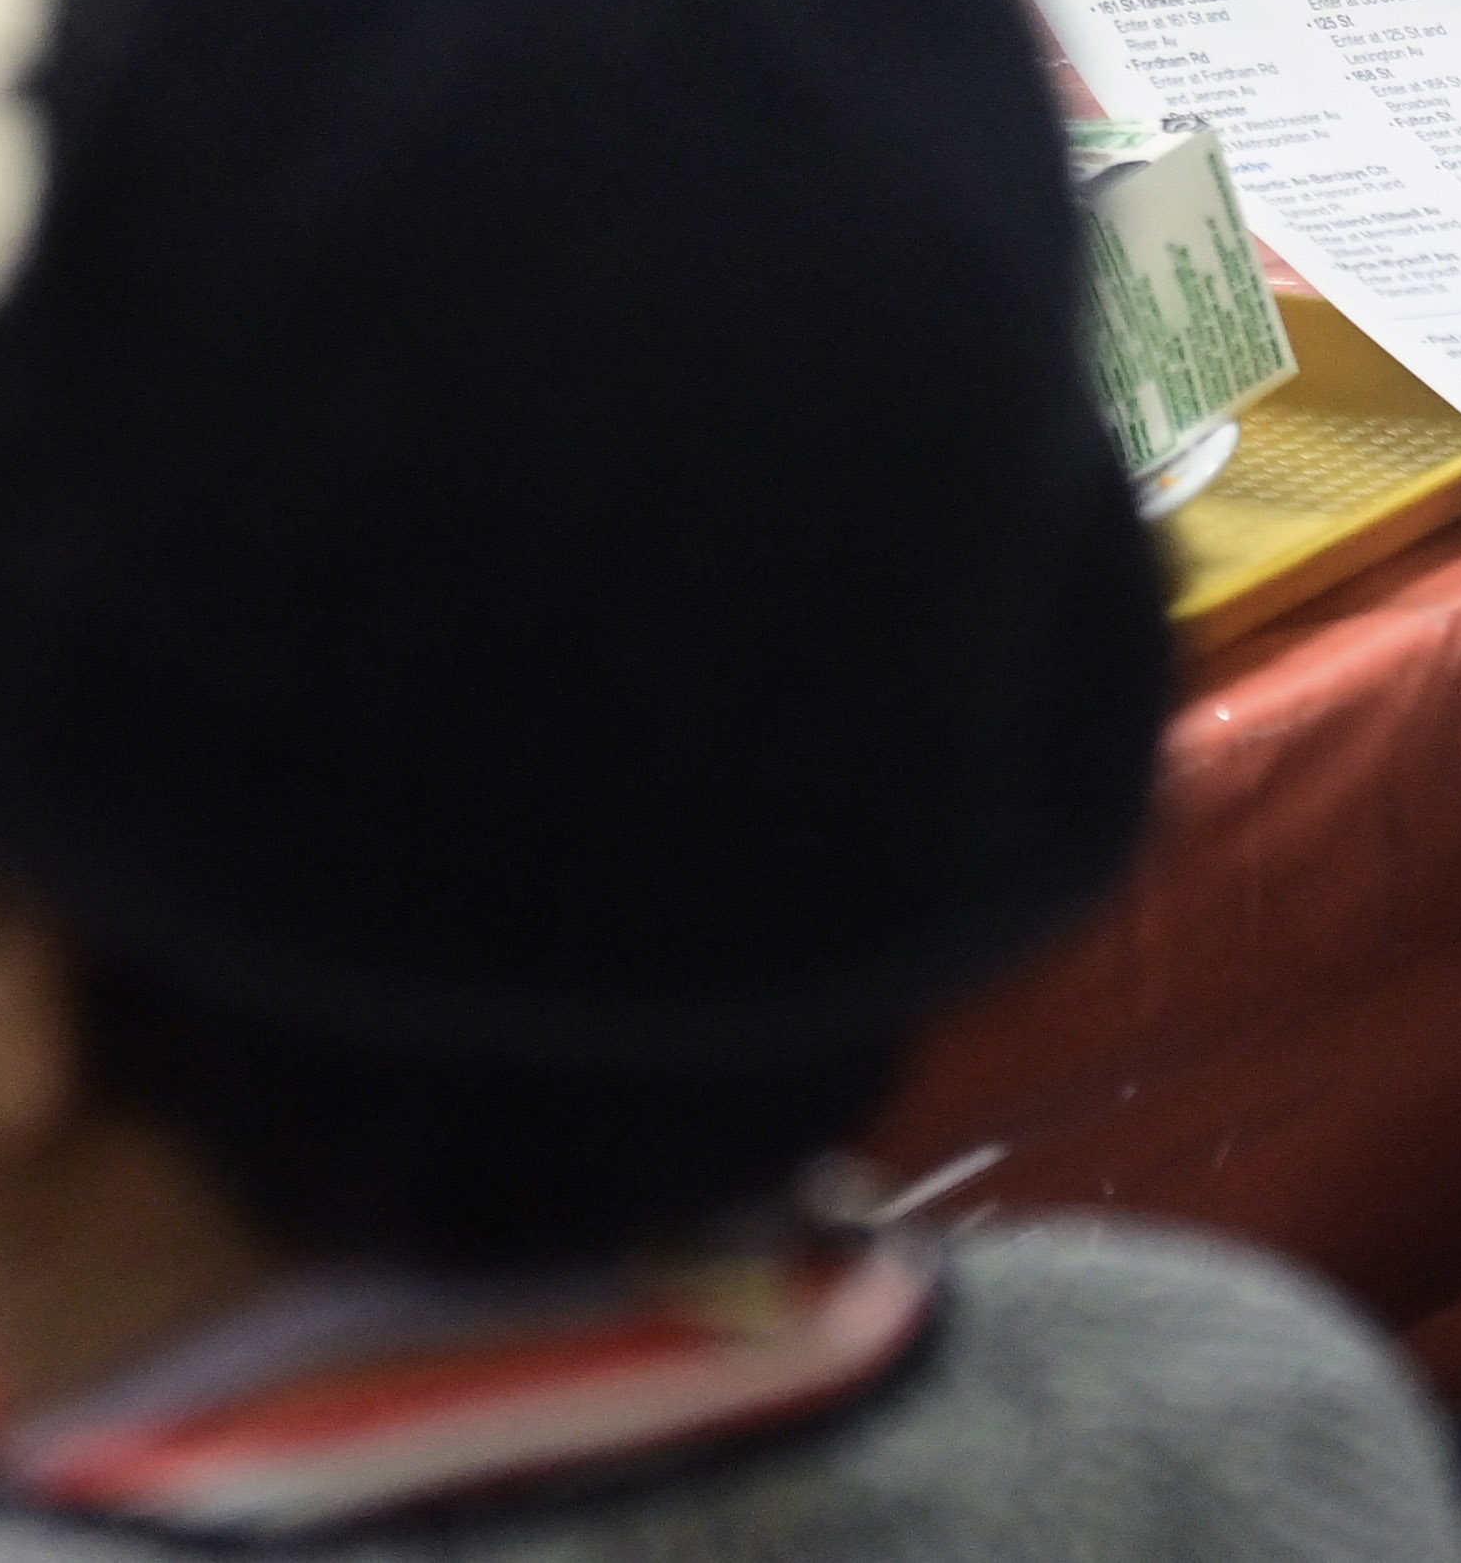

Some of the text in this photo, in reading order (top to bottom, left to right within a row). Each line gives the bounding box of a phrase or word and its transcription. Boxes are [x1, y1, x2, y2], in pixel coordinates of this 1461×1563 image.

[1098, 0, 1122, 15] 161
[1113, 19, 1149, 34] Enter
[1152, 17, 1166, 29] at
[1187, 11, 1206, 25] St
[1207, 8, 1230, 22] and
[1313, 14, 1354, 30] 125 St
[1331, 33, 1366, 48] Enter
[1369, 32, 1382, 44] at
[1405, 26, 1422, 40] St
[1423, 23, 1448, 37] and
[1130, 51, 1211, 71] Fordham Rd
[1343, 46, 1424, 65] Lexington Av
[1376, 67, 1395, 80] St
[1393, 111, 1456, 129] Fulton St
